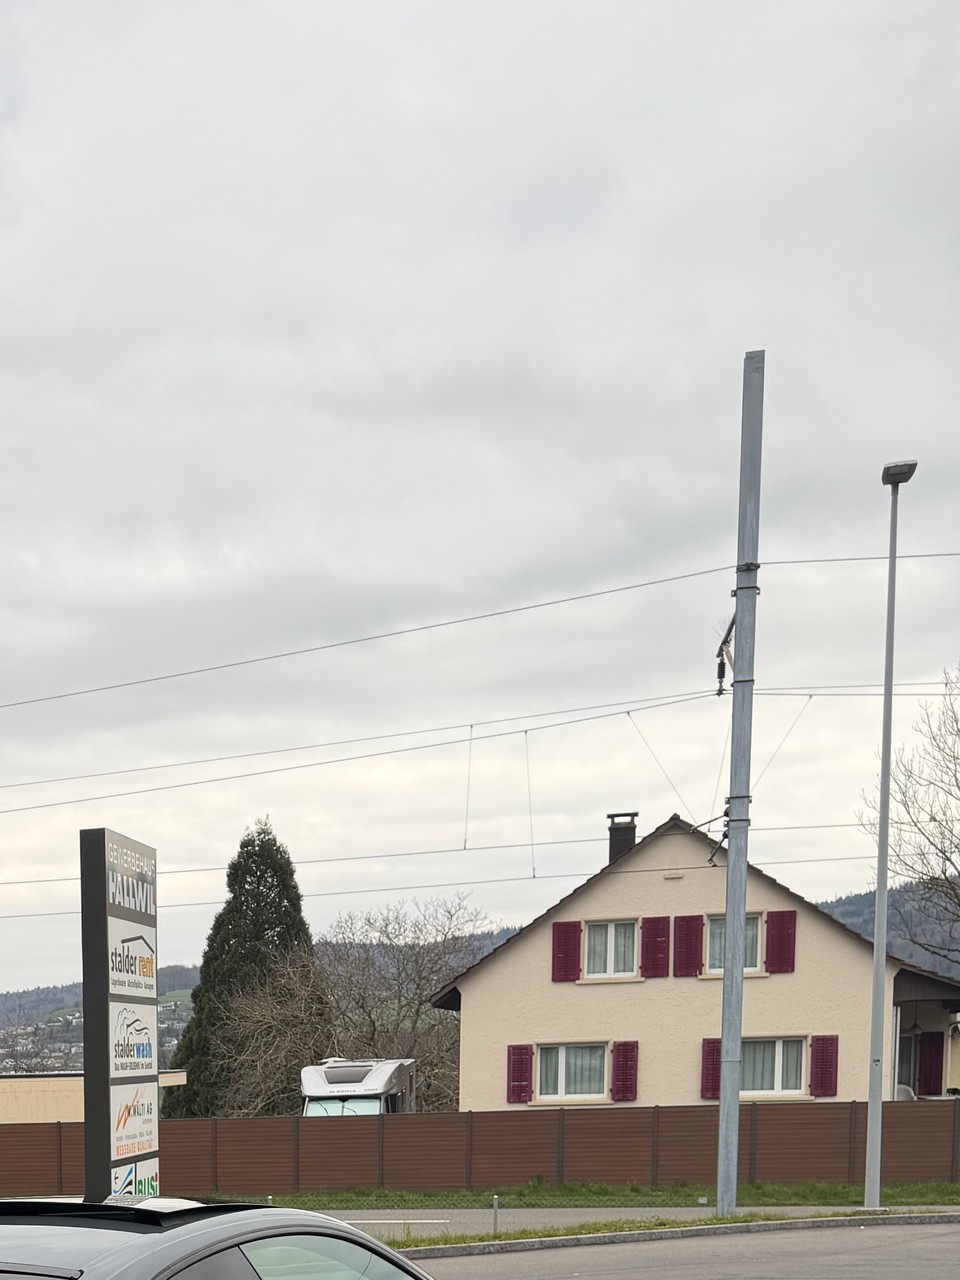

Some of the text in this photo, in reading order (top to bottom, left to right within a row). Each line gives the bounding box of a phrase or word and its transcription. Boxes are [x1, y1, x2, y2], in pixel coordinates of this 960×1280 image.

[108, 842, 155, 878] GEWERBEHAUS
[109, 870, 155, 915] HALLWIL
[111, 944, 154, 978] stalder rent
